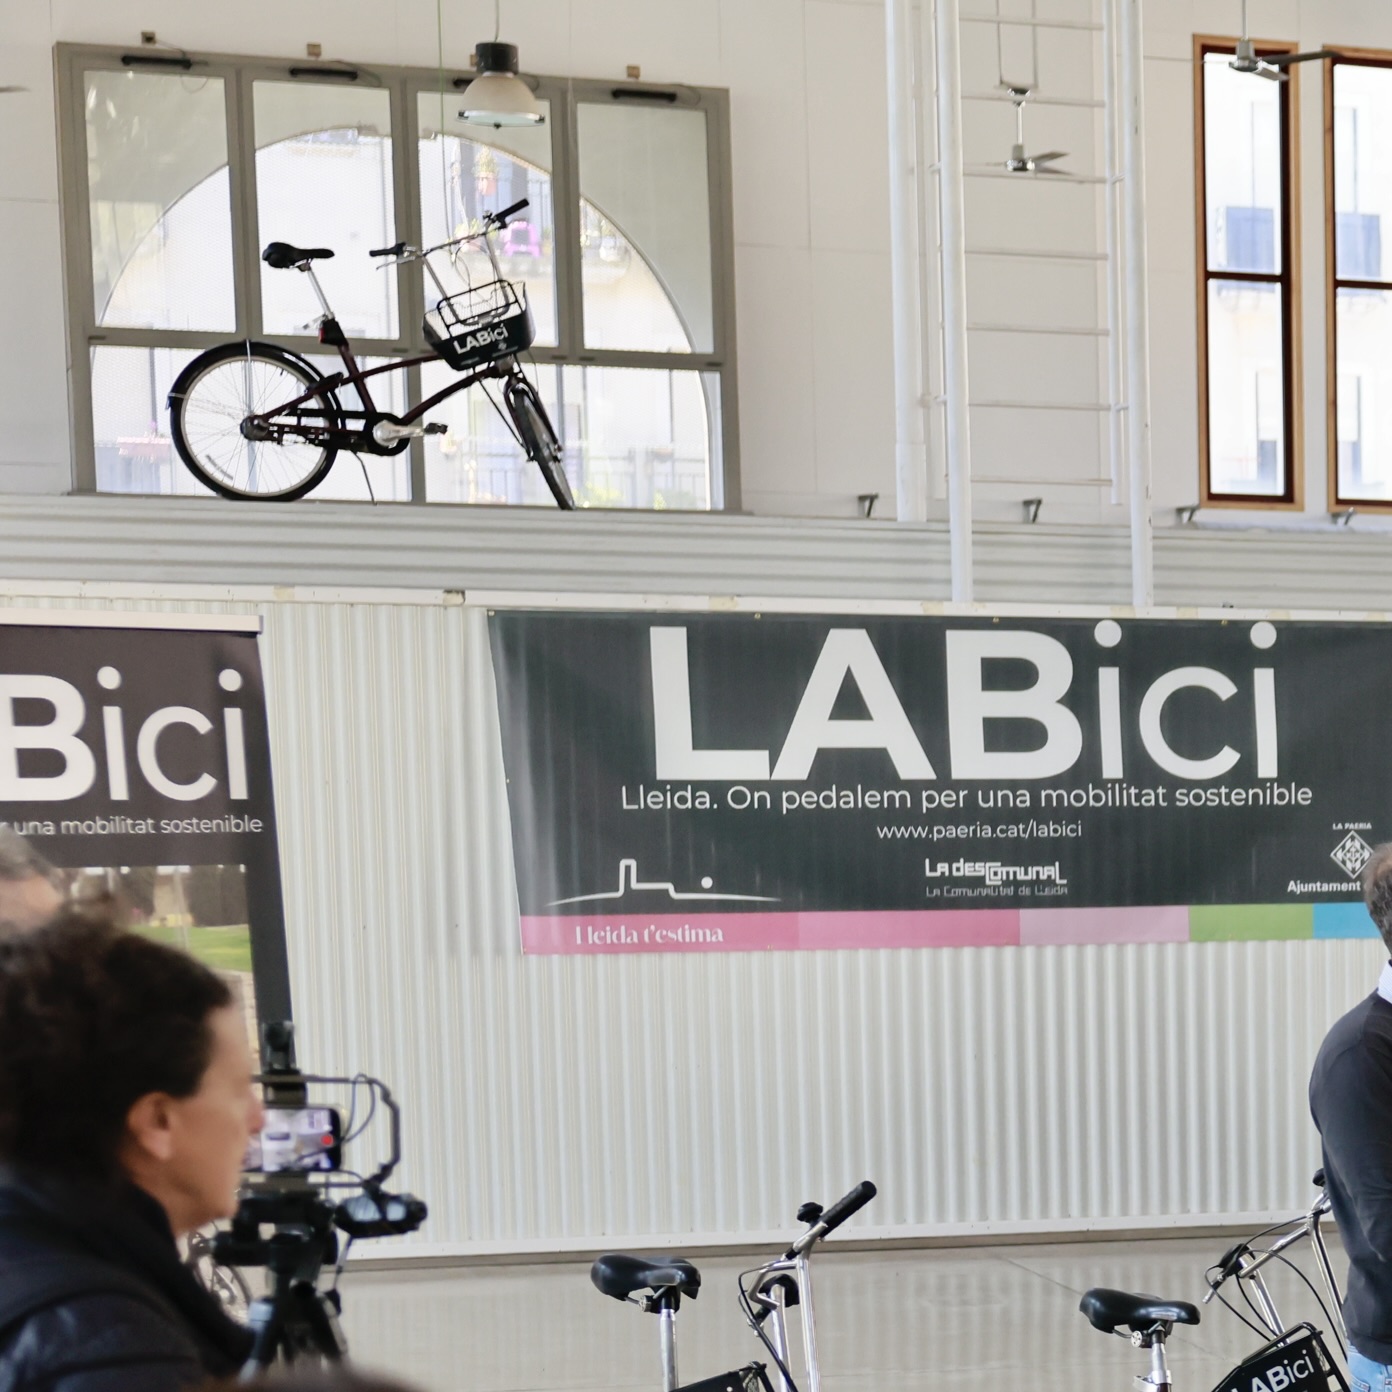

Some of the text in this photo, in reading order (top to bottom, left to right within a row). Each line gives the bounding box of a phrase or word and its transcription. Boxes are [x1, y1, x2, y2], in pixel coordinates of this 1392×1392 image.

[453, 323, 508, 354] LABici
[649, 619, 1279, 781] LABici
[621, 782, 1313, 814] Lleida. On pedalem per una mobilitat sostenible
[14, 820, 55, 835] una
[61, 815, 155, 835] mobilitat
[160, 814, 263, 834] sostenible
[876, 818, 1082, 842] www.paeria.cat/labici
[1287, 880, 1361, 895] Ajuntament
